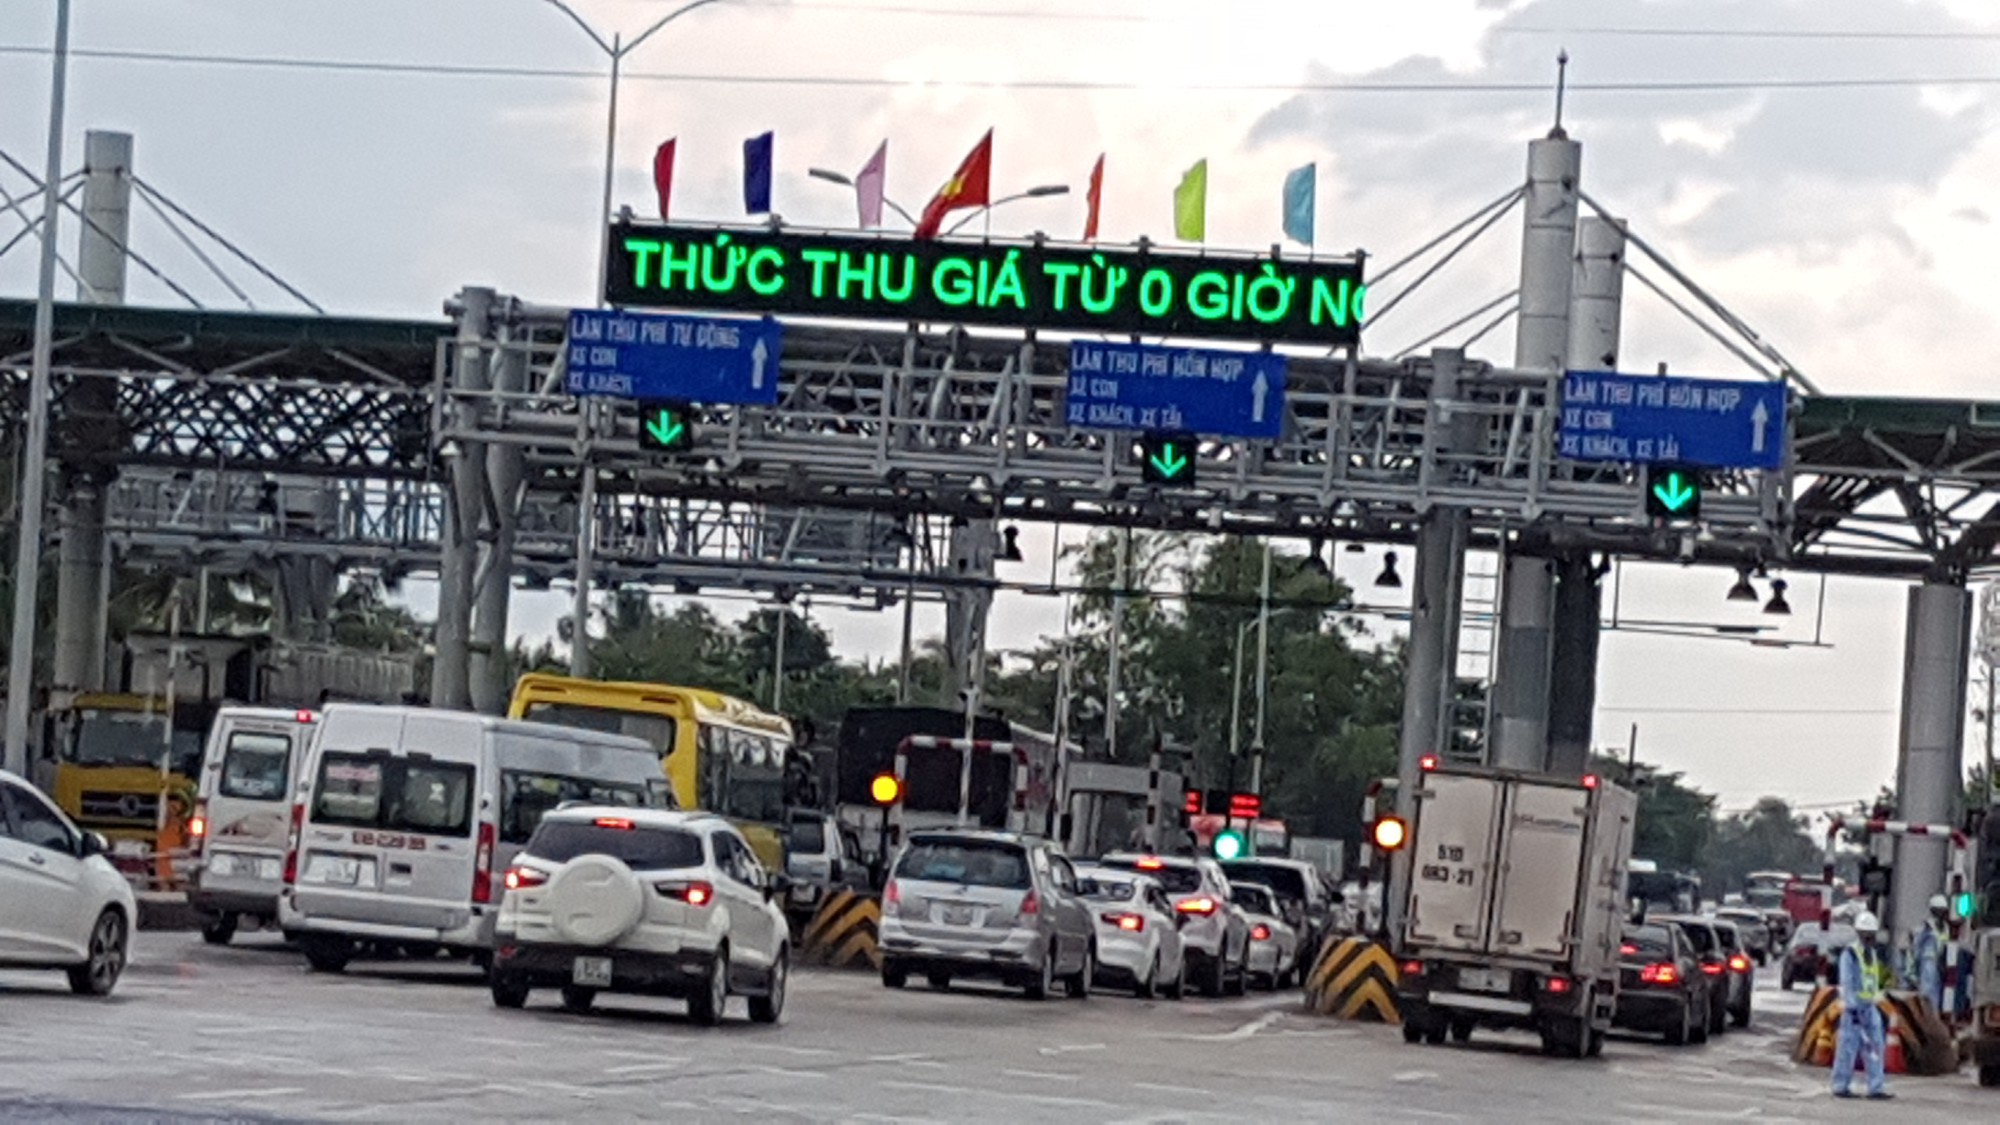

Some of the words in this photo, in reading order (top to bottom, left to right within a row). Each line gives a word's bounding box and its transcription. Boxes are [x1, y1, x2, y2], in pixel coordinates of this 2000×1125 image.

[625, 234, 785, 295] THỨC
[801, 250, 915, 302] THU
[932, 249, 1026, 308] GIÁ
[1043, 253, 1127, 313] TỪ
[1139, 269, 1173, 316] 0
[1187, 262, 1296, 322] GIỜ
